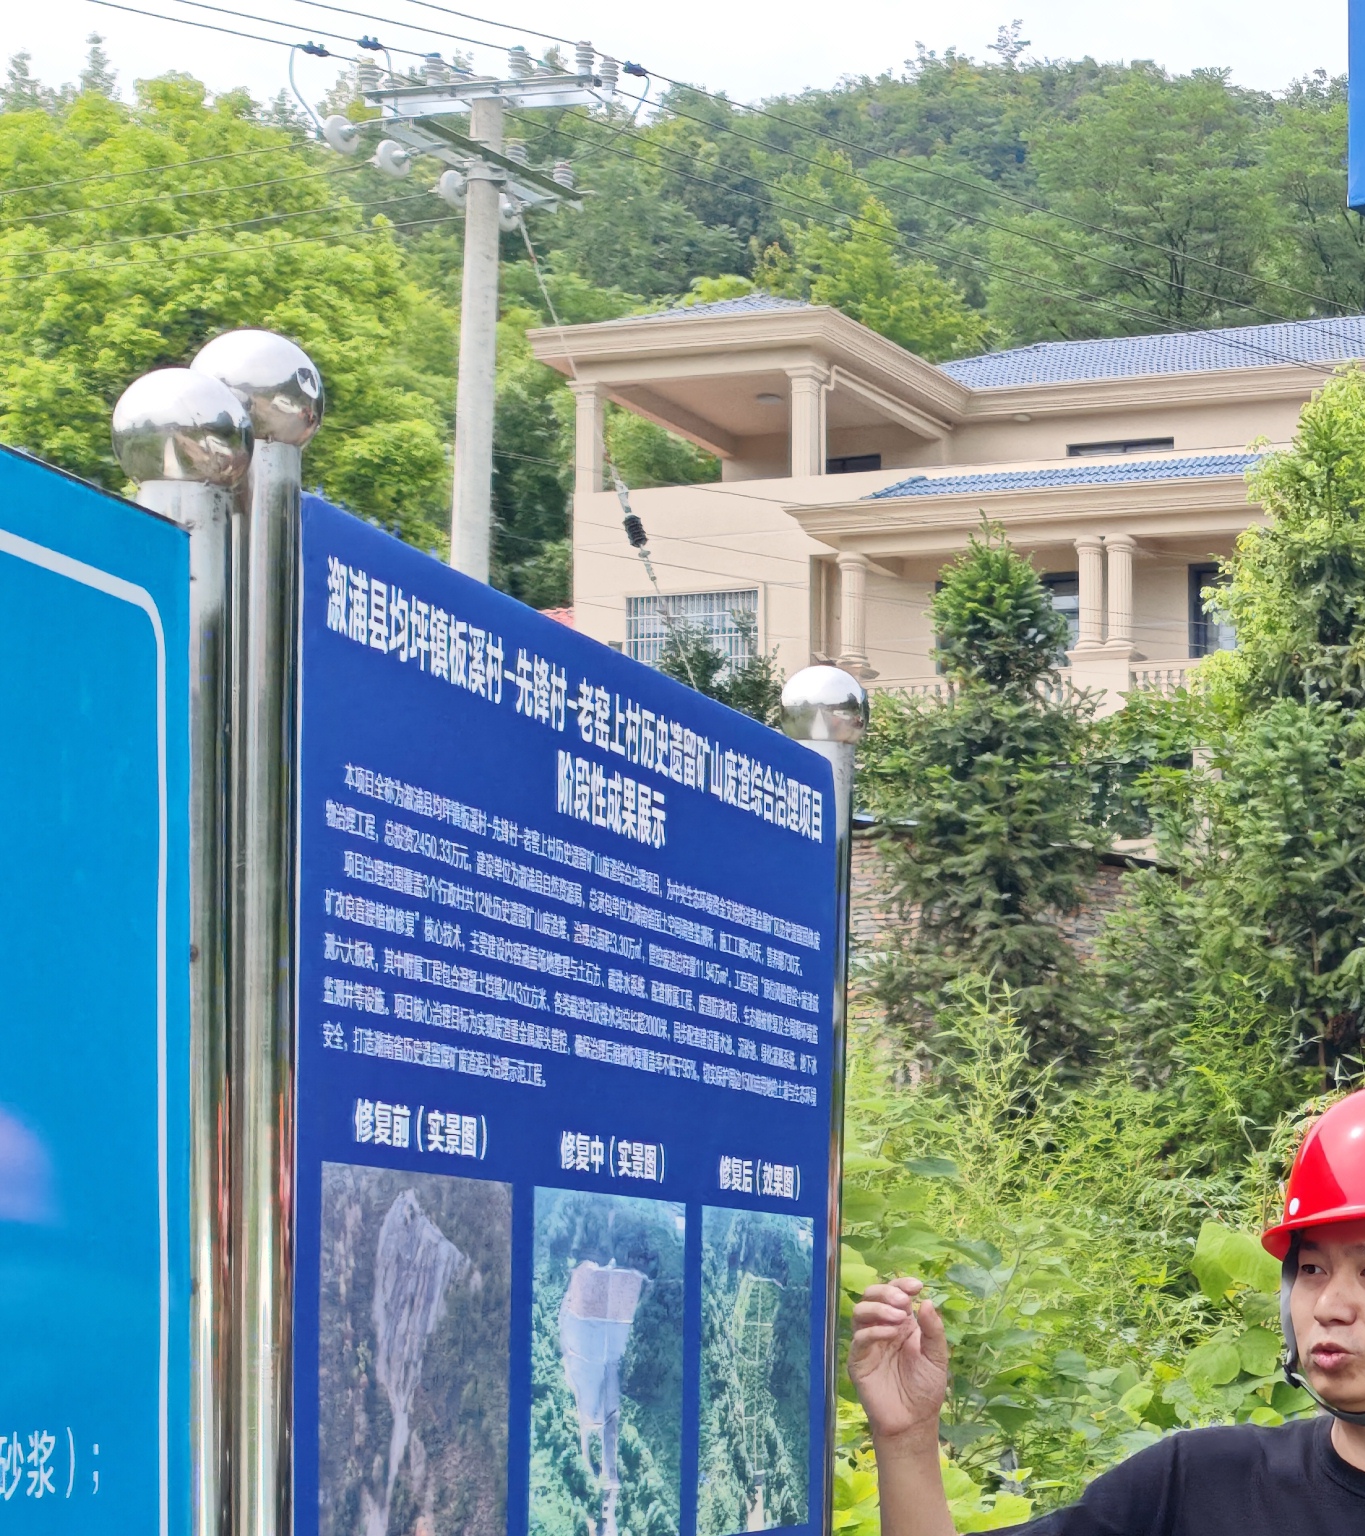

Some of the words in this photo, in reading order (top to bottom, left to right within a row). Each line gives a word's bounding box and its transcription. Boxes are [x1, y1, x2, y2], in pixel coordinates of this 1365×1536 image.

[557, 749, 667, 850] 阶段性成果展示
